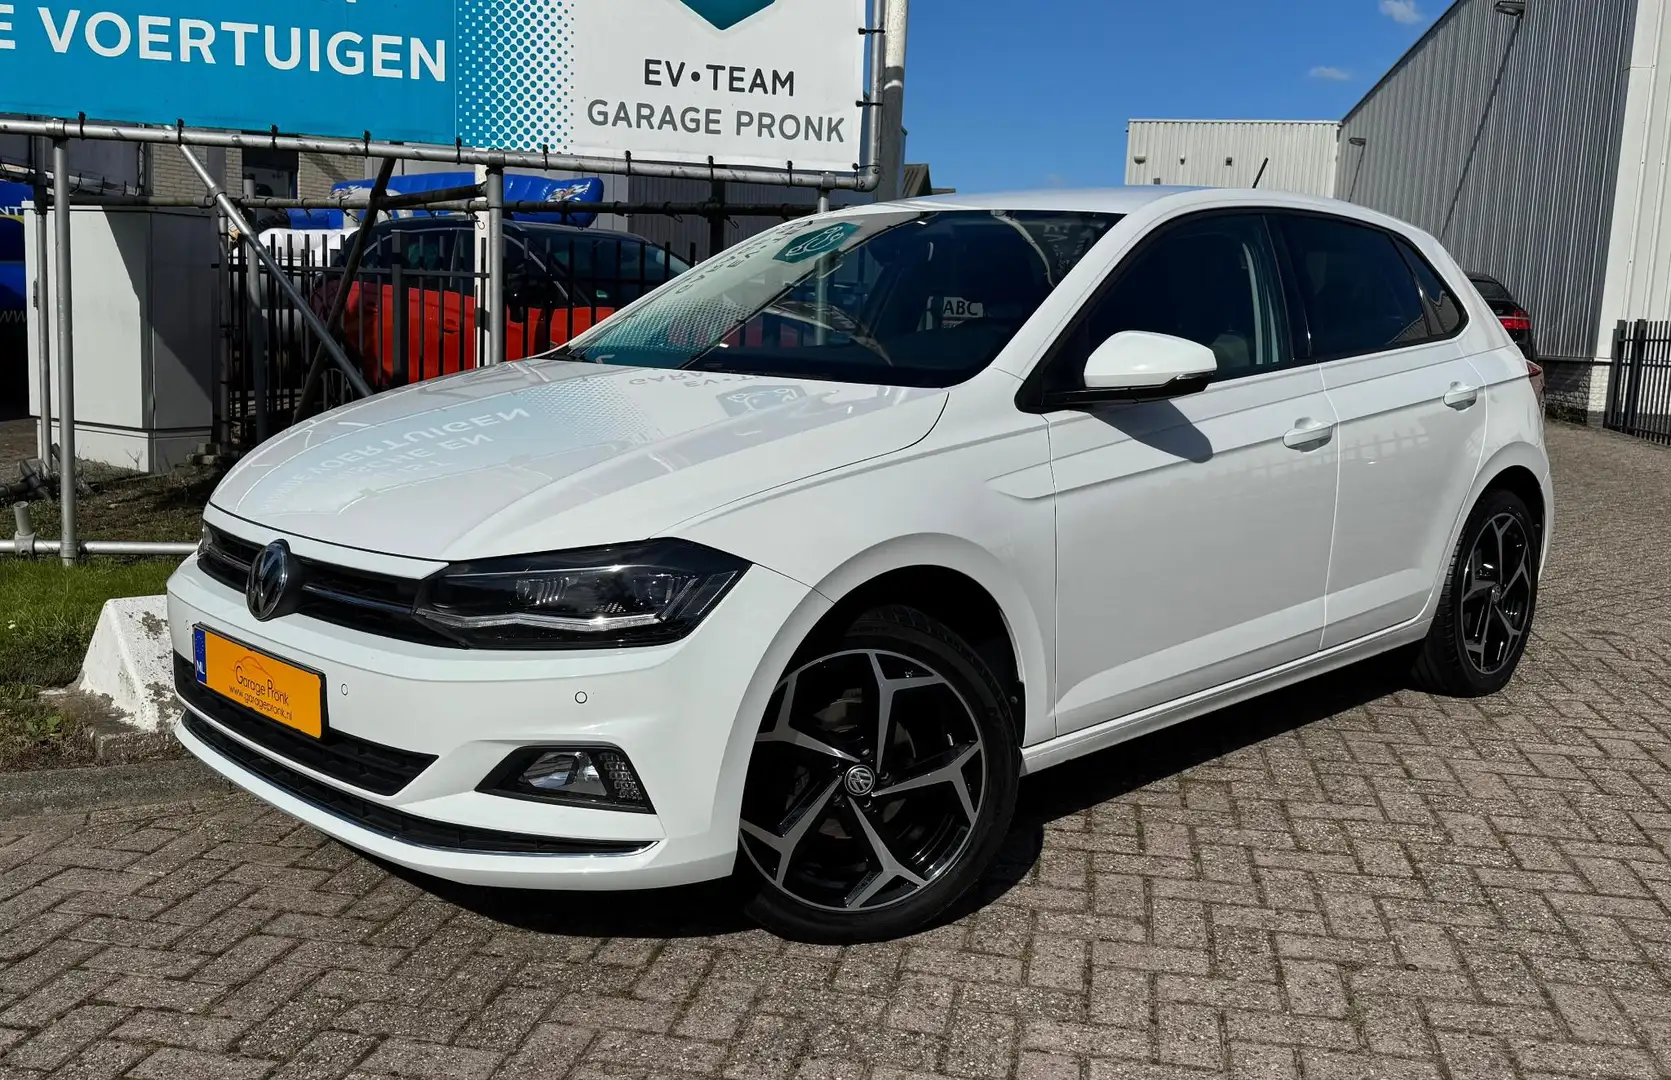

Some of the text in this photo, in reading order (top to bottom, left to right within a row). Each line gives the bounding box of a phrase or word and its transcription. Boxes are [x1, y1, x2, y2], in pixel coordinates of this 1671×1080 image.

[37, 6, 446, 83] VOERTUIGEN
[587, 99, 845, 143] GARAGE PRONK
[943, 299, 978, 316] ABC
[235, 665, 290, 706] Garage Pronk
